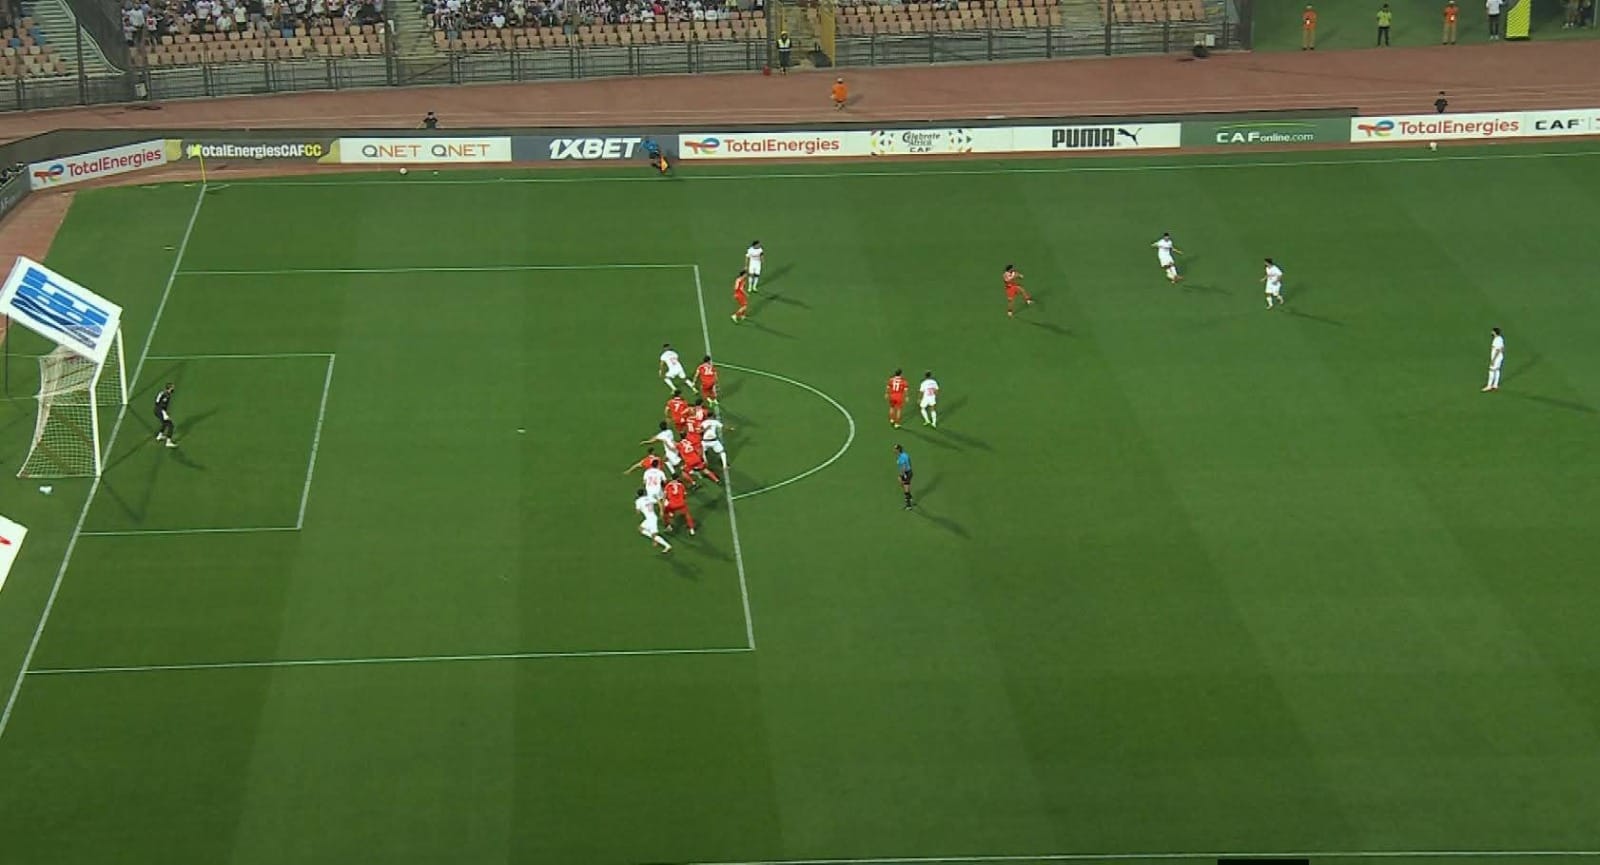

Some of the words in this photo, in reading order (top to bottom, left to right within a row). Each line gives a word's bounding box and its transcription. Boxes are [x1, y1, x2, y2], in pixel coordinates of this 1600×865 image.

[1400, 118, 1519, 136] TotalEnergies
[1535, 118, 1580, 130] CAF
[724, 137, 840, 155] TotalEnergies
[1052, 128, 1115, 148] PUMA
[361, 144, 422, 158] QNET
[431, 143, 490, 157] QNET
[550, 138, 641, 160] 1XBET
[67, 148, 161, 177] TotalEnergies
